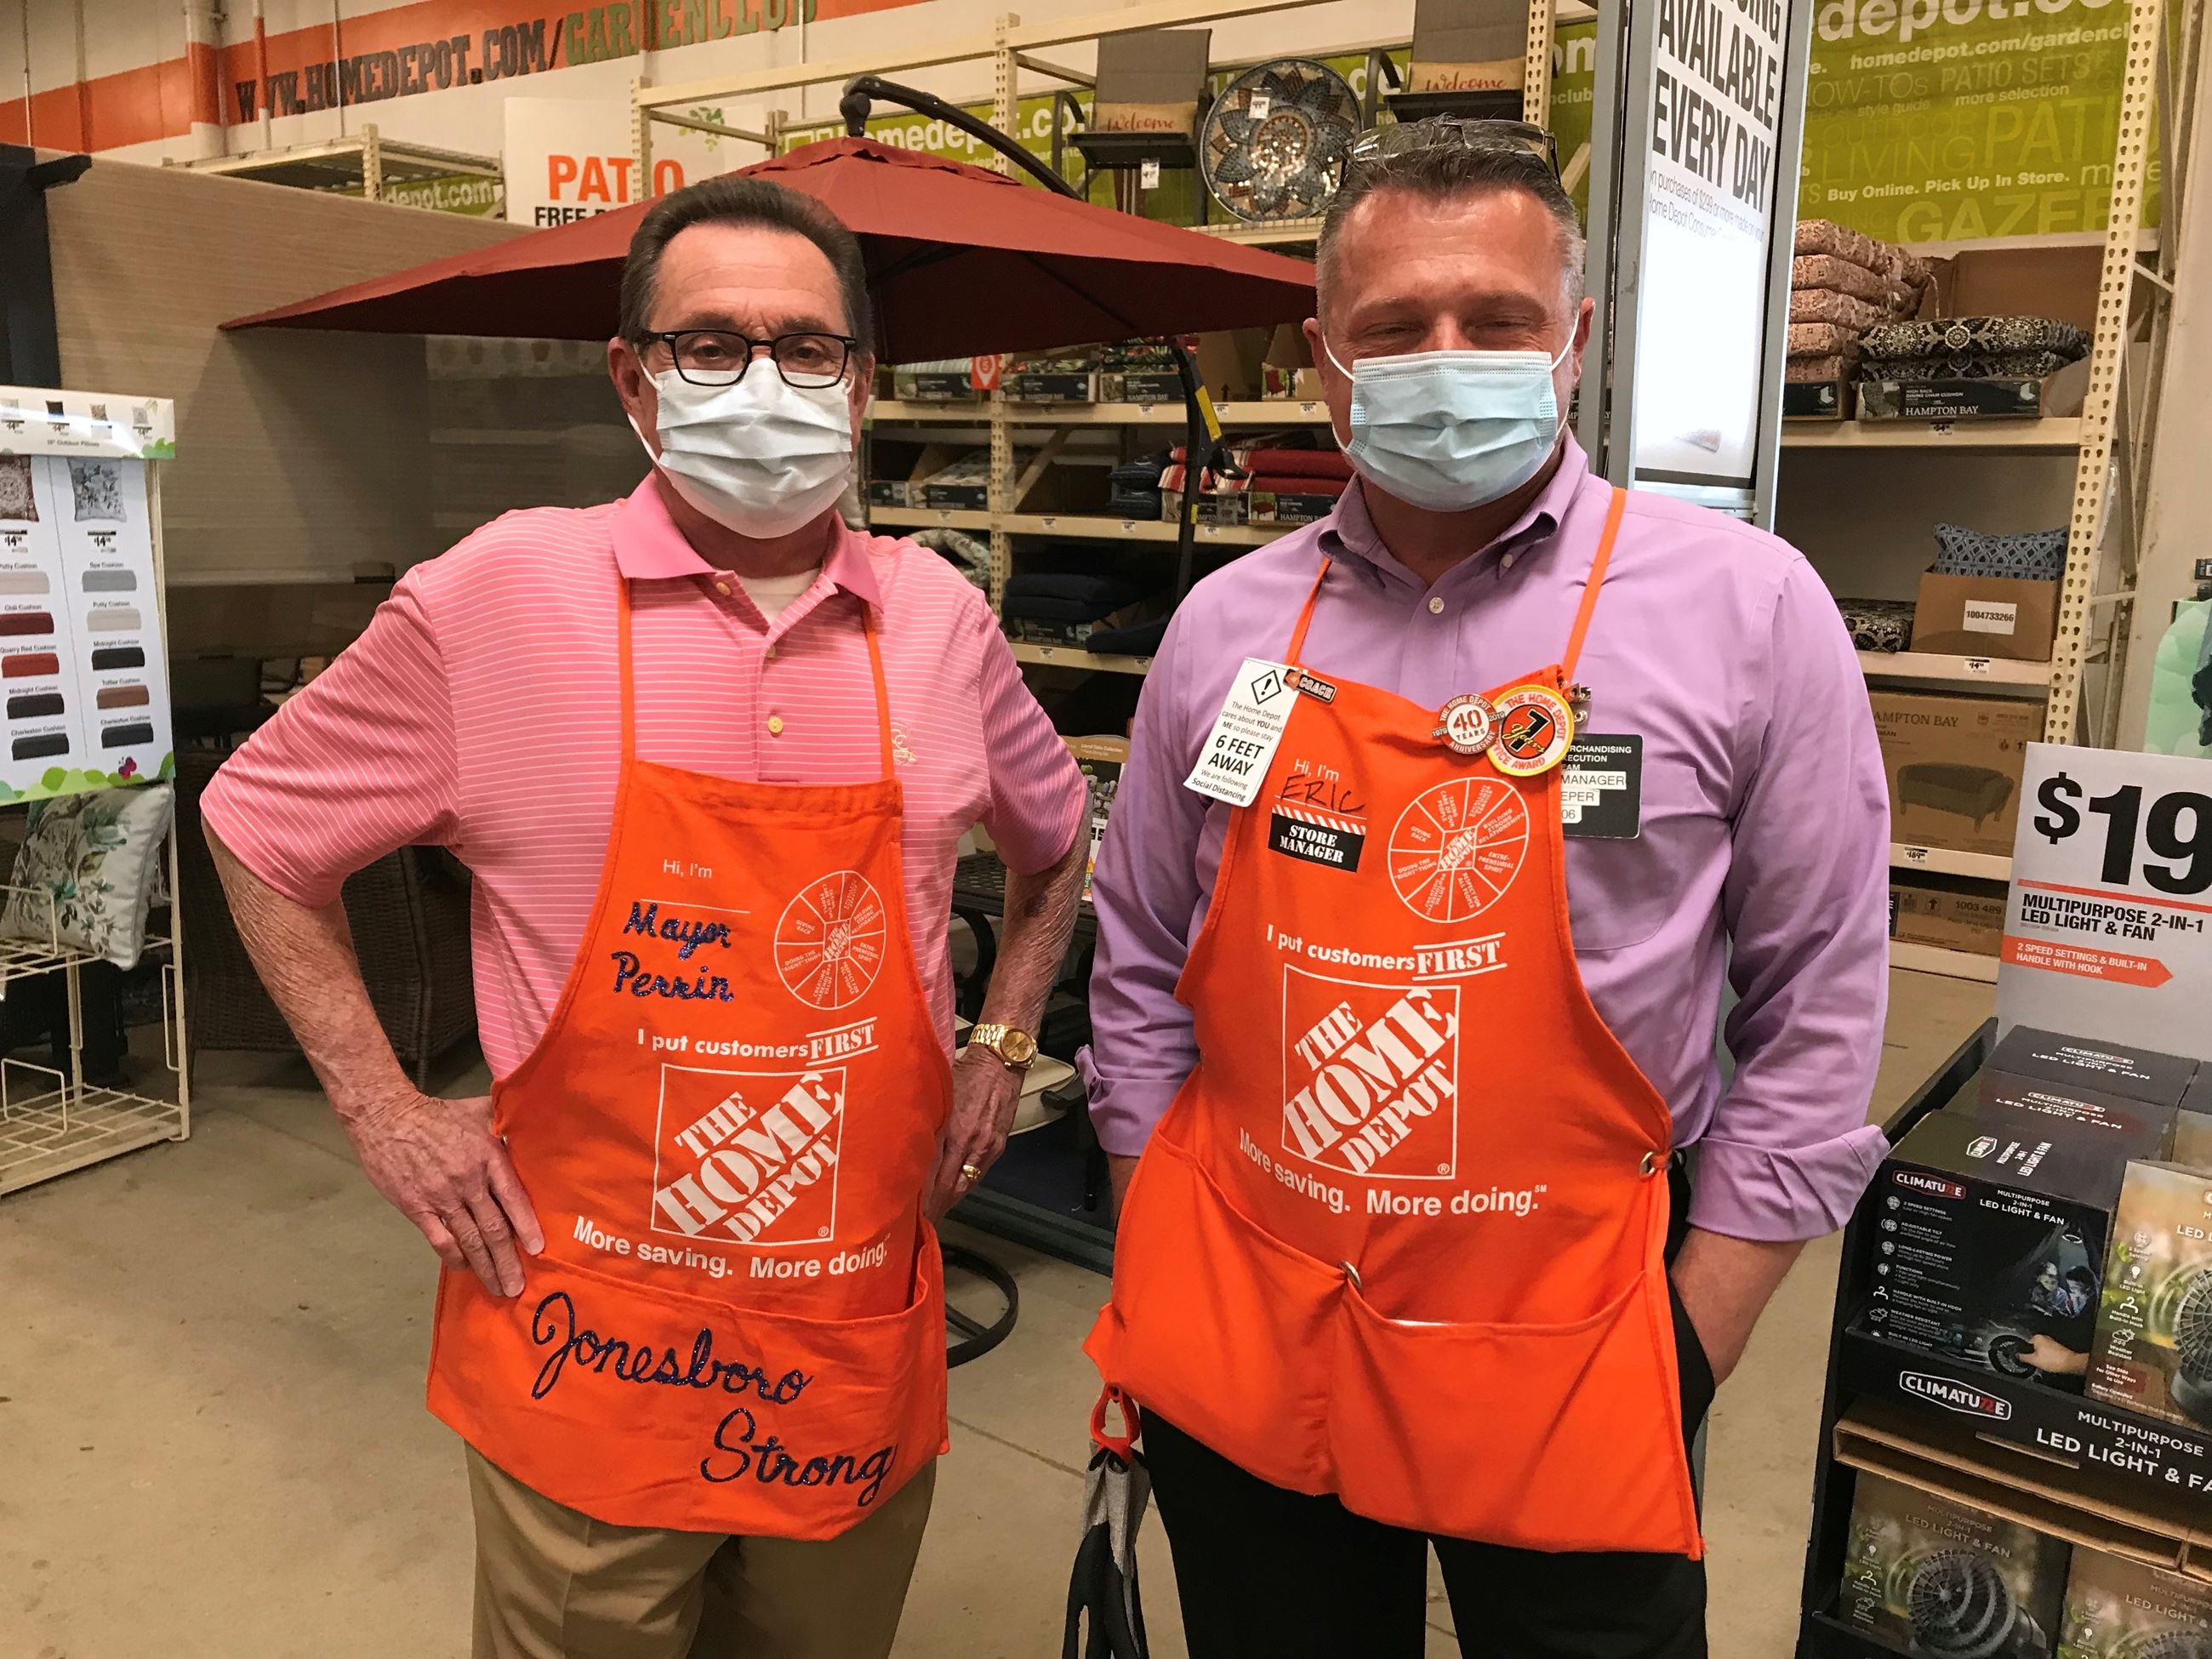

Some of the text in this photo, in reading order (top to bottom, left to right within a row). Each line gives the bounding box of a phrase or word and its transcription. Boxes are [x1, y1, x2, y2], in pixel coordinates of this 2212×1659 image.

[1850, 23, 2129, 71] homedepot.com/gardencl
[1658, 0, 1776, 131] AVAILABLE
[1940, 59, 2013, 94] PATIO
[2022, 51, 2090, 84] SETS
[1427, 71, 1506, 91] Welcome
[1857, 101, 1889, 118] style
[1892, 100, 1930, 117] guide
[1956, 92, 1994, 107] more
[1998, 83, 2069, 102] selection
[1108, 111, 1176, 130] Welcome
[1652, 67, 1730, 189] EVERY
[1732, 123, 1770, 213] DAY
[1821, 95, 2159, 184] LIVING PATI
[548, 155, 685, 204] PATO
[1827, 189, 1857, 202] Buy
[1861, 184, 1919, 198] Online.
[1924, 179, 1961, 192] Pick
[1966, 176, 1990, 191] Up
[1994, 174, 2012, 187] In
[2016, 171, 2070, 185] Store.
[1906, 405, 1979, 416] HAMPTON BAY
[1965, 609, 2015, 622] 1004733266
[1299, 676, 1334, 700] COACH
[1232, 701, 1281, 721] The Home Depot
[1448, 696, 1491, 711] HOME DEPOT
[1488, 711, 1506, 722] 2019
[1505, 693, 1566, 741] THE HOME DEPOT
[1222, 710, 1283, 733] cares about YOU and
[1222, 721, 1274, 743] ME please stay
[1431, 727, 1448, 738] 1979
[1452, 709, 1483, 733] 40
[1873, 712, 1959, 727] AMPTON BAY
[1216, 735, 1265, 760] 6 FEET
[1448, 730, 1497, 754] ANNIVERSARY
[1456, 728, 1486, 742] YEARS
[1207, 752, 1255, 777] AWAY
[1511, 757, 1546, 771] AWARD
[1569, 745, 1632, 755] RCHANDISING
[1222, 775, 1249, 791] following
[1293, 758, 1341, 782] Hi, I'm
[1191, 778, 1247, 803] Social Distancing
[1280, 773, 1366, 812] ERIC
[1289, 824, 1339, 847] STORE
[1478, 811, 1526, 845] RELATIONSHIPS
[2033, 772, 2212, 895] $19
[1280, 834, 1344, 864] MANAGER
[662, 858, 713, 879] Hi, I'm
[1955, 900, 2002, 915] 1003 489
[2023, 893, 2147, 924] MULTIPURPOSE
[2151, 912, 2204, 933] 2-IN-1
[623, 901, 733, 961] Mayor
[2021, 908, 2050, 924] LED
[2055, 913, 2101, 933] LIGHT
[2104, 921, 2118, 935] &
[2122, 925, 2156, 941] FAN
[1266, 924, 1502, 975] I put customers FIRST
[2016, 952, 2104, 975] HANDLE WITH HOOK
[2017, 943, 2147, 972] 2 SPEED SETTINGS & BUILT-IN
[611, 951, 734, 1002] Perrin
[637, 1023, 875, 1060] I put customers FIRST
[1293, 1001, 1364, 1072] THE
[1285, 988, 1457, 1160] HOME
[673, 1091, 758, 1159] THE
[1338, 1058, 1457, 1175] DEPOT
[653, 1071, 843, 1237] HOME
[1239, 1126, 1540, 1217] More saving. More doing.
[722, 1133, 839, 1243] DEPOT
[1997, 1189, 2050, 1207] MULTIPURPOSE
[1979, 1199, 2065, 1226] LED LIGHT & FAN
[2013, 1200, 2032, 1210] 2-IN-1
[2176, 1224, 2204, 1240] LED
[573, 1215, 888, 1279] More saving. More doing.
[531, 1291, 815, 1405] Jonesboro
[2078, 1410, 2205, 1457] MULTIPURPOSE
[2114, 1437, 2162, 1459] 2-IN-1
[700, 1406, 900, 1508] Strong
[2036, 1428, 2212, 1492] LED LIGHT & FA
[1927, 1504, 1993, 1532] MULTIPURPOSE
[1906, 1514, 2011, 1559] LED LIGHT FAN
[2125, 1593, 2196, 1623] LED LIGHT
